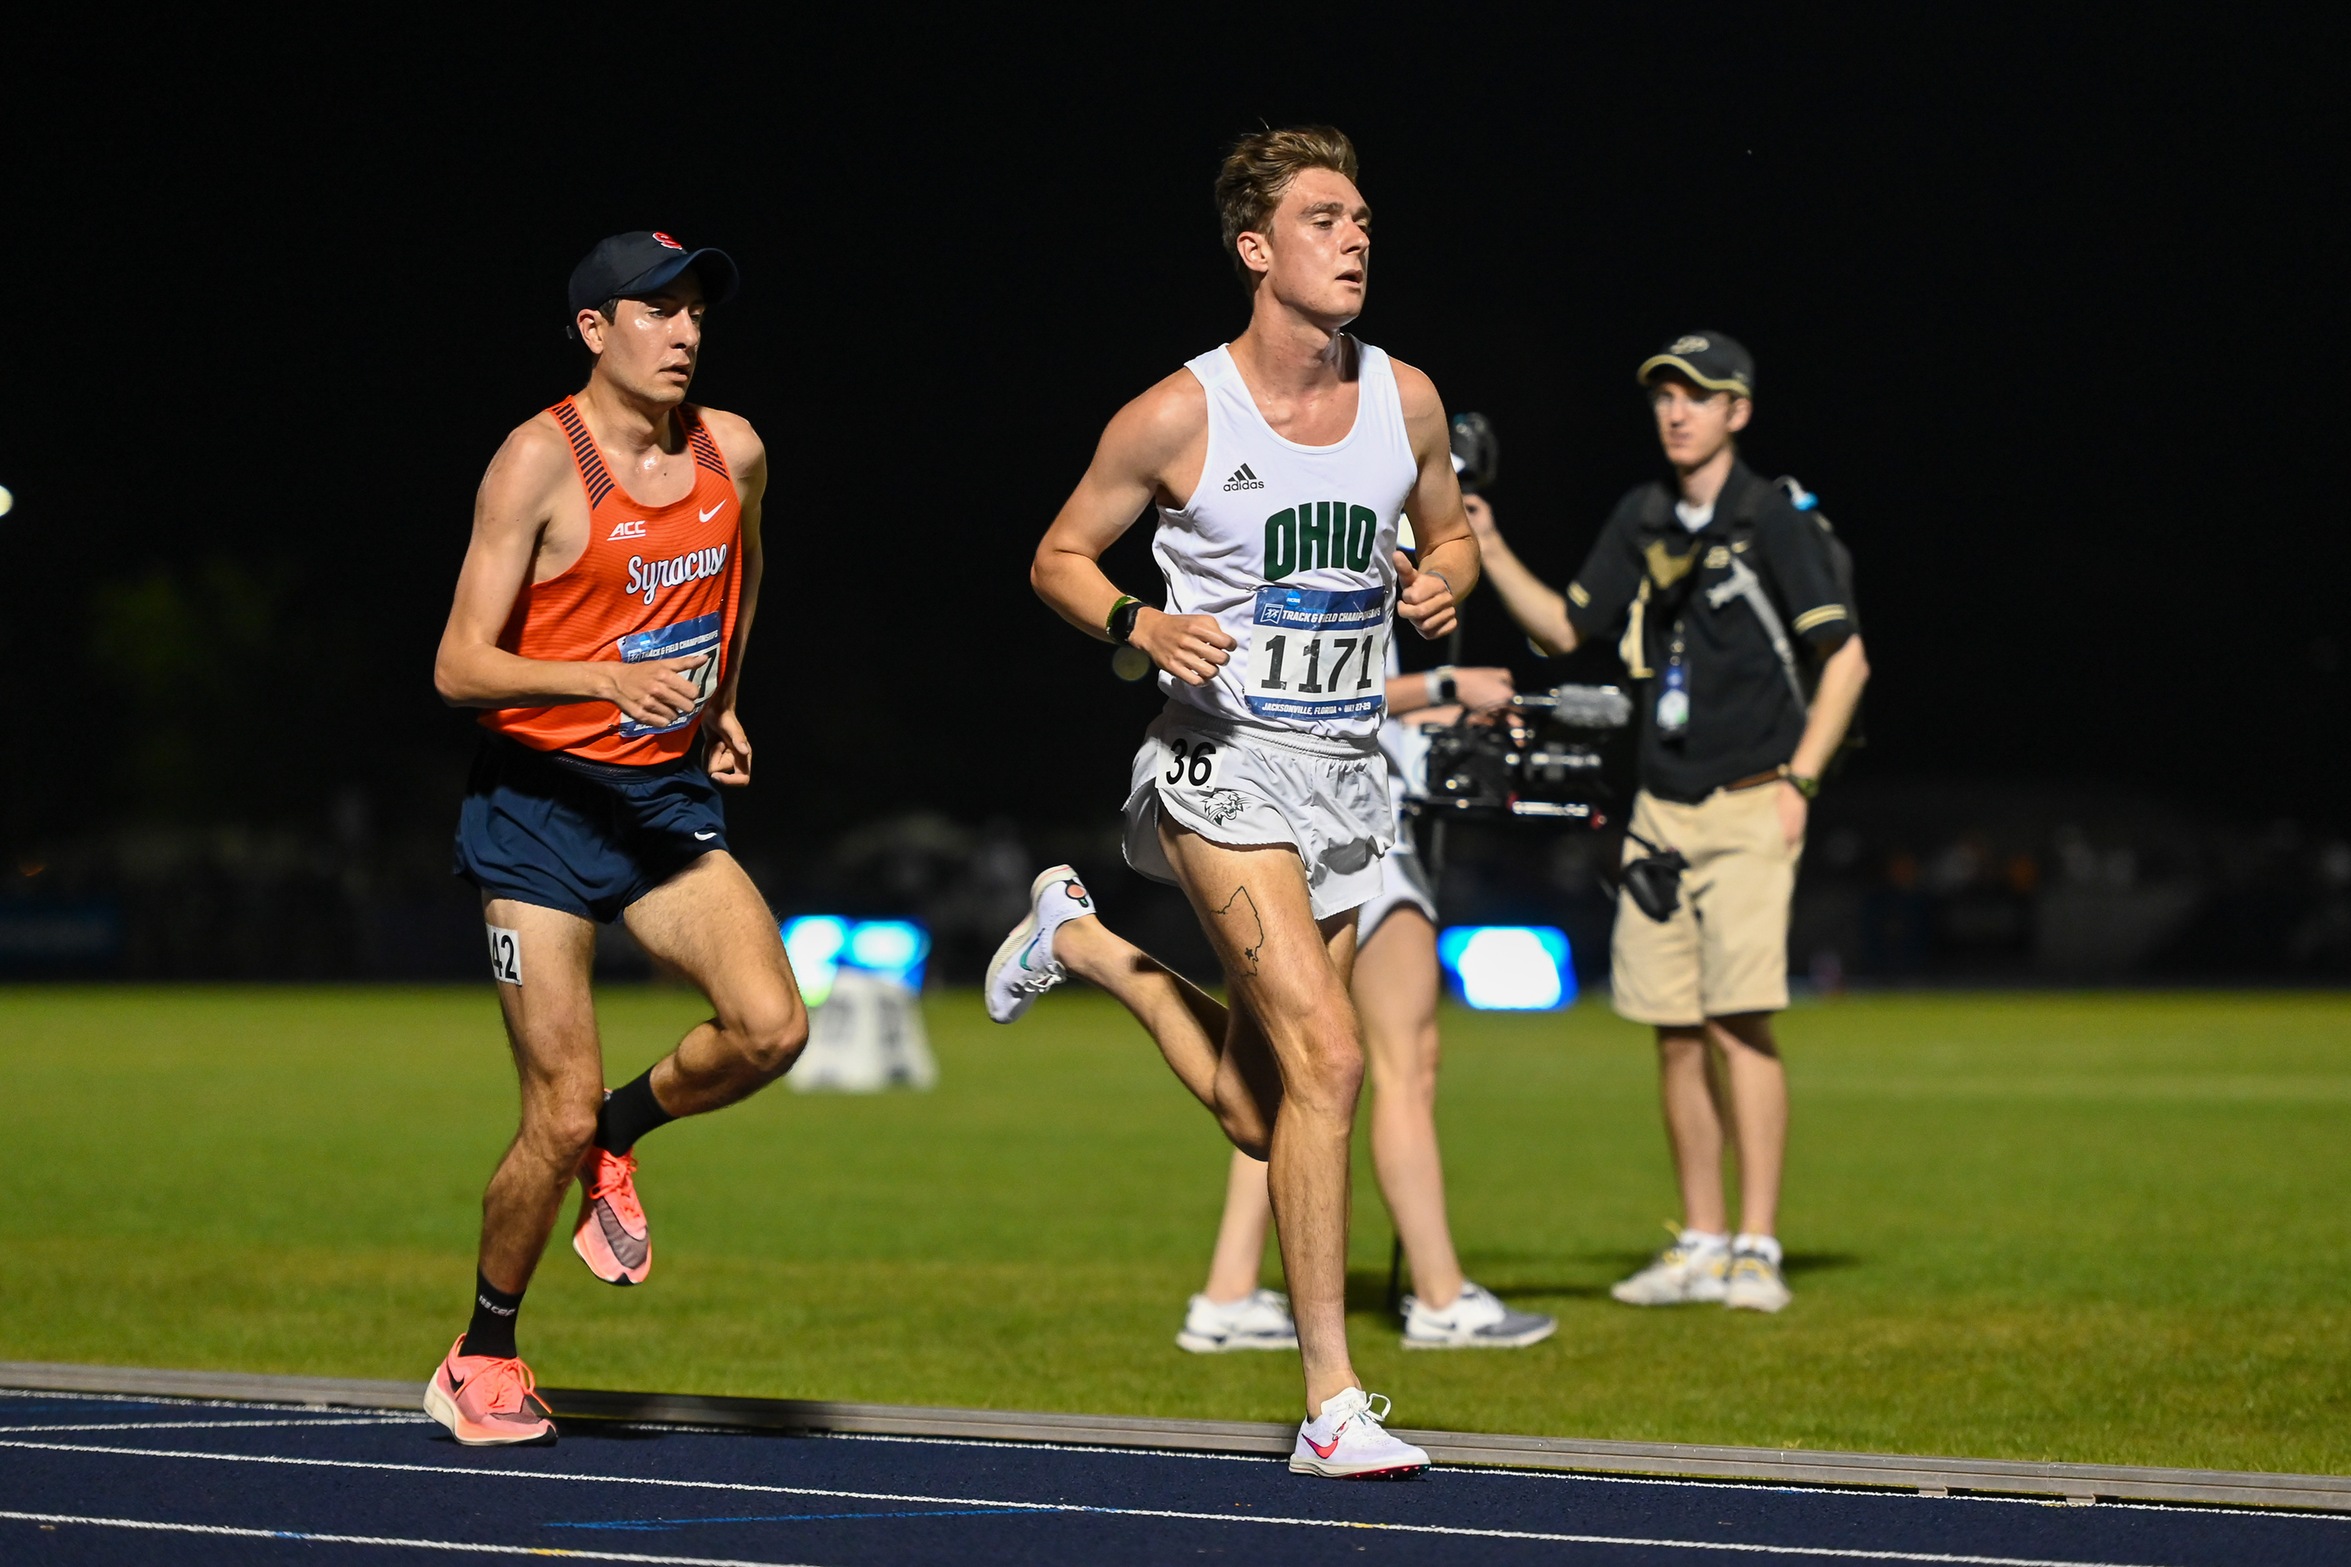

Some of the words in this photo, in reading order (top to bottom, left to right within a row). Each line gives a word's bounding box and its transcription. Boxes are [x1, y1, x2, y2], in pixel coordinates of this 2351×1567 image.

[1223, 479, 1265, 492] adidas
[609, 520, 647, 538] ACC
[1264, 501, 1377, 582] OHIO
[625, 543, 728, 606] Syracuse
[1282, 609, 1311, 623] TRACK
[1310, 613, 1319, 623] &
[1318, 612, 1339, 623] FIELD
[1261, 635, 1373, 694] 1171
[1262, 702, 1313, 715] JACKSONVILLE,
[1165, 738, 1217, 786] 36
[492, 931, 518, 980] 42
